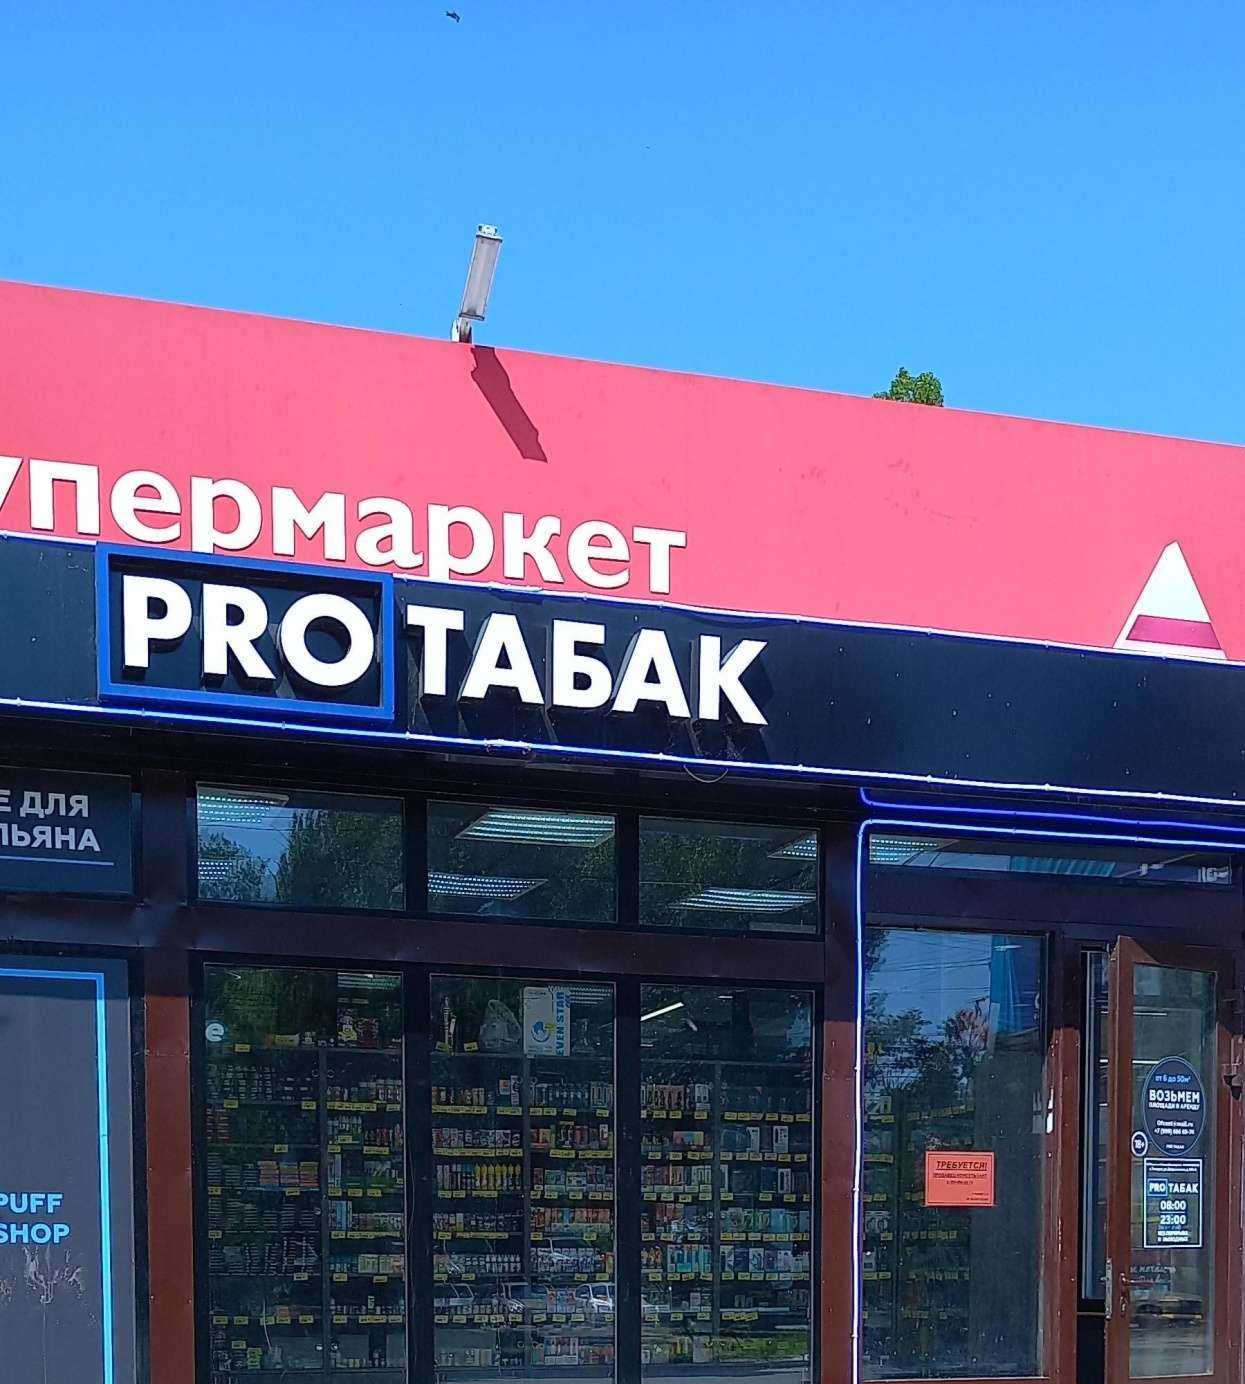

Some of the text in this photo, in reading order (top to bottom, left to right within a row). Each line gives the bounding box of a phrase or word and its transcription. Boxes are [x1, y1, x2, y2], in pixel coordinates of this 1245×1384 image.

[121, 574, 769, 726] PRO ТАБАК
[20, 790, 89, 819] ДЛЯ
[1149, 1089, 1201, 1104] ВОЗЬМЕМ
[1149, 1182, 1199, 1194] PRO ТАБАК
[1160, 1200, 1187, 1211] 08:00
[1160, 1214, 1187, 1225] 23:00
[0, 1223, 70, 1244] SHOP
